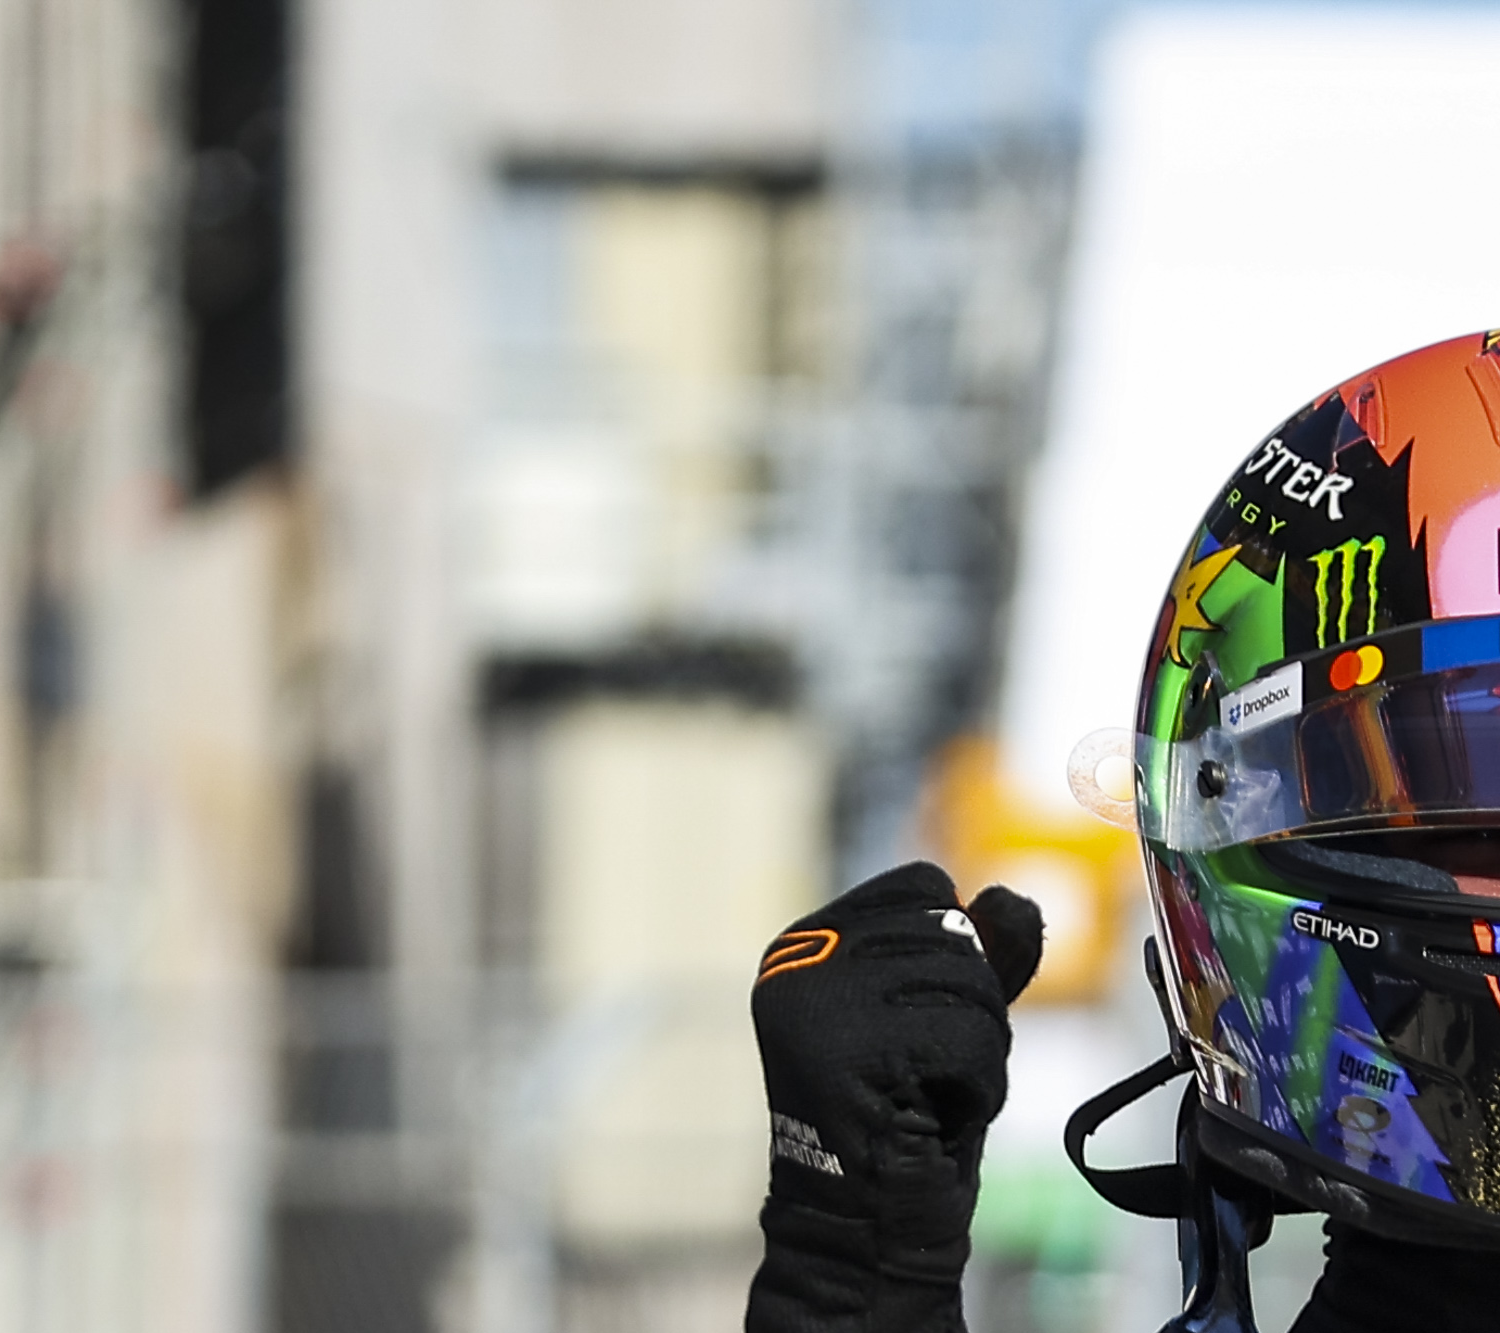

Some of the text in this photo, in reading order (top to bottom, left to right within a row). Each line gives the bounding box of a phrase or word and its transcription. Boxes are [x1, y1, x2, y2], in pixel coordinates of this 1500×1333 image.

[1245, 438, 1354, 521] STER
[1226, 488, 1288, 535] RGY
[1242, 684, 1291, 718] Dropbox
[1293, 911, 1380, 949] ETIHAD
